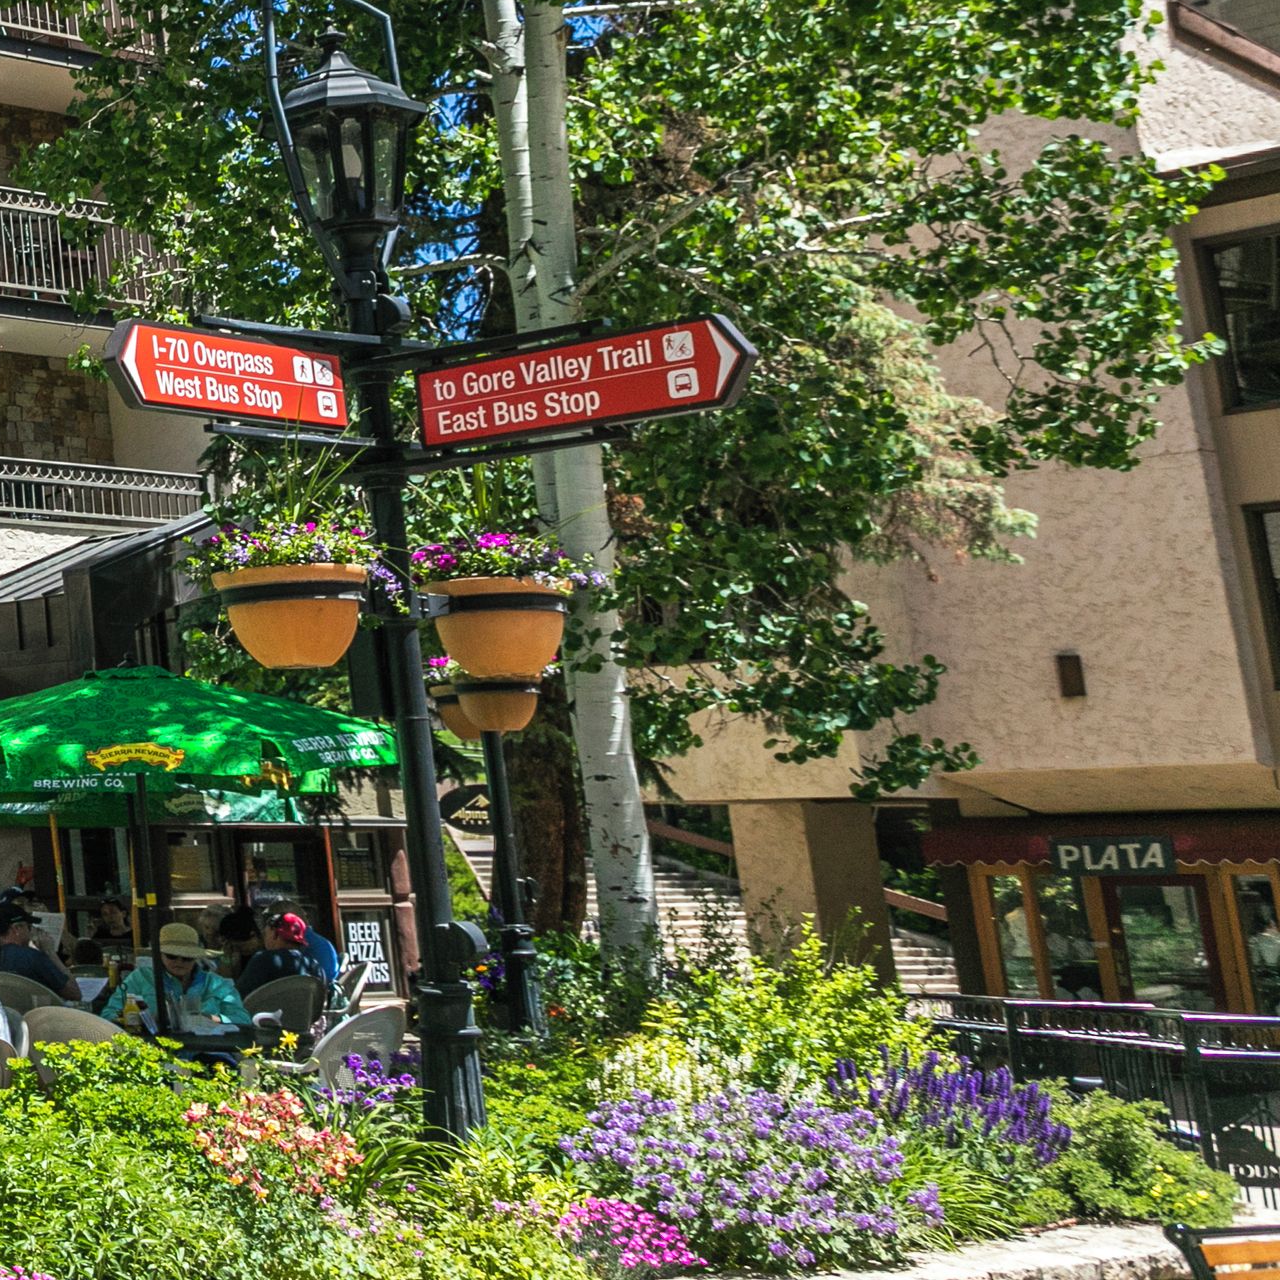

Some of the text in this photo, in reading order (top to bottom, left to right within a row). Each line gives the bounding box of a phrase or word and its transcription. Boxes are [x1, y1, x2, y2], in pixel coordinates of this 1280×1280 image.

[152, 334, 274, 376] I-70 Overpass
[434, 338, 653, 401] to Gore Valley Trail
[155, 369, 283, 413] West Bus Stop
[437, 389, 601, 435] East Bus Stop
[100, 748, 170, 760] SIERRA NEVADA
[292, 731, 388, 752] SIERRA NEVADA
[33, 777, 124, 789] BREWING CO.
[1057, 842, 1165, 871] PLATA
[348, 921, 381, 942] BEER
[348, 941, 385, 962] PIZZA
